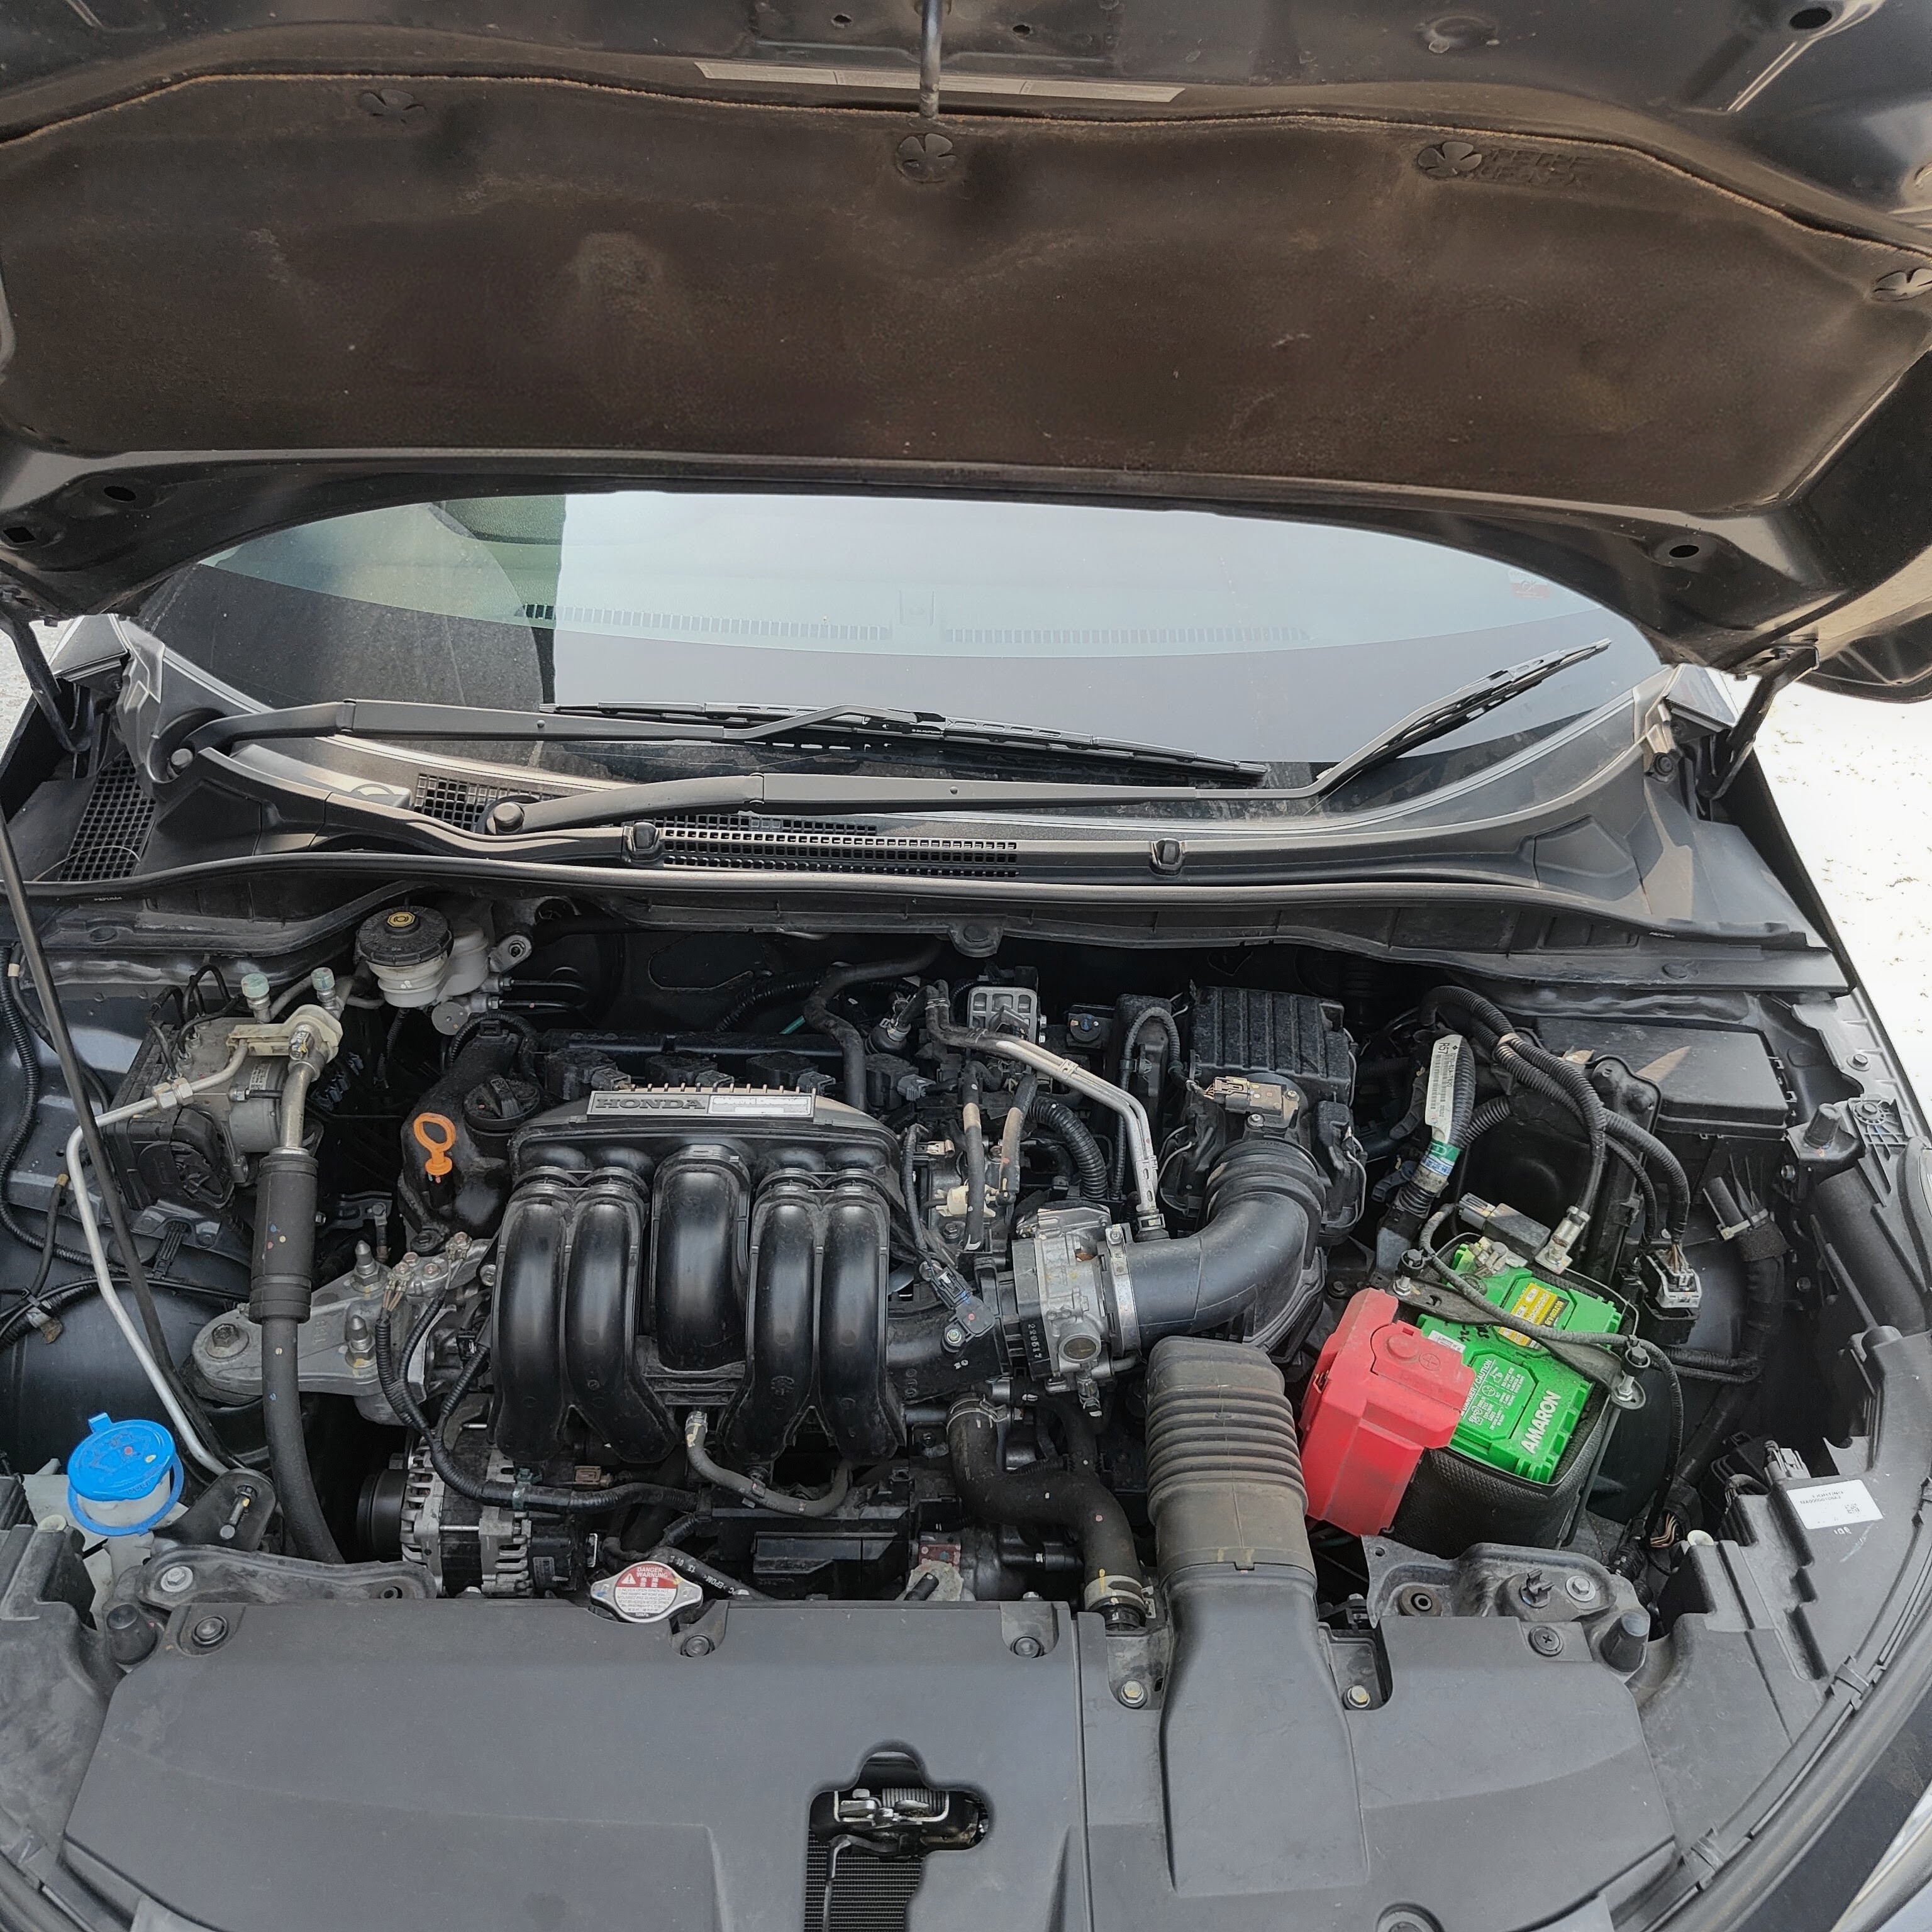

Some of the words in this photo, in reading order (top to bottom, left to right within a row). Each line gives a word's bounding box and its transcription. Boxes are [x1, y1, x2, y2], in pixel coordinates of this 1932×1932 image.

[1438, 1043, 1450, 1055] R57
[596, 1099, 706, 1109] HONDA
[1521, 1389, 1562, 1454] AMARON
